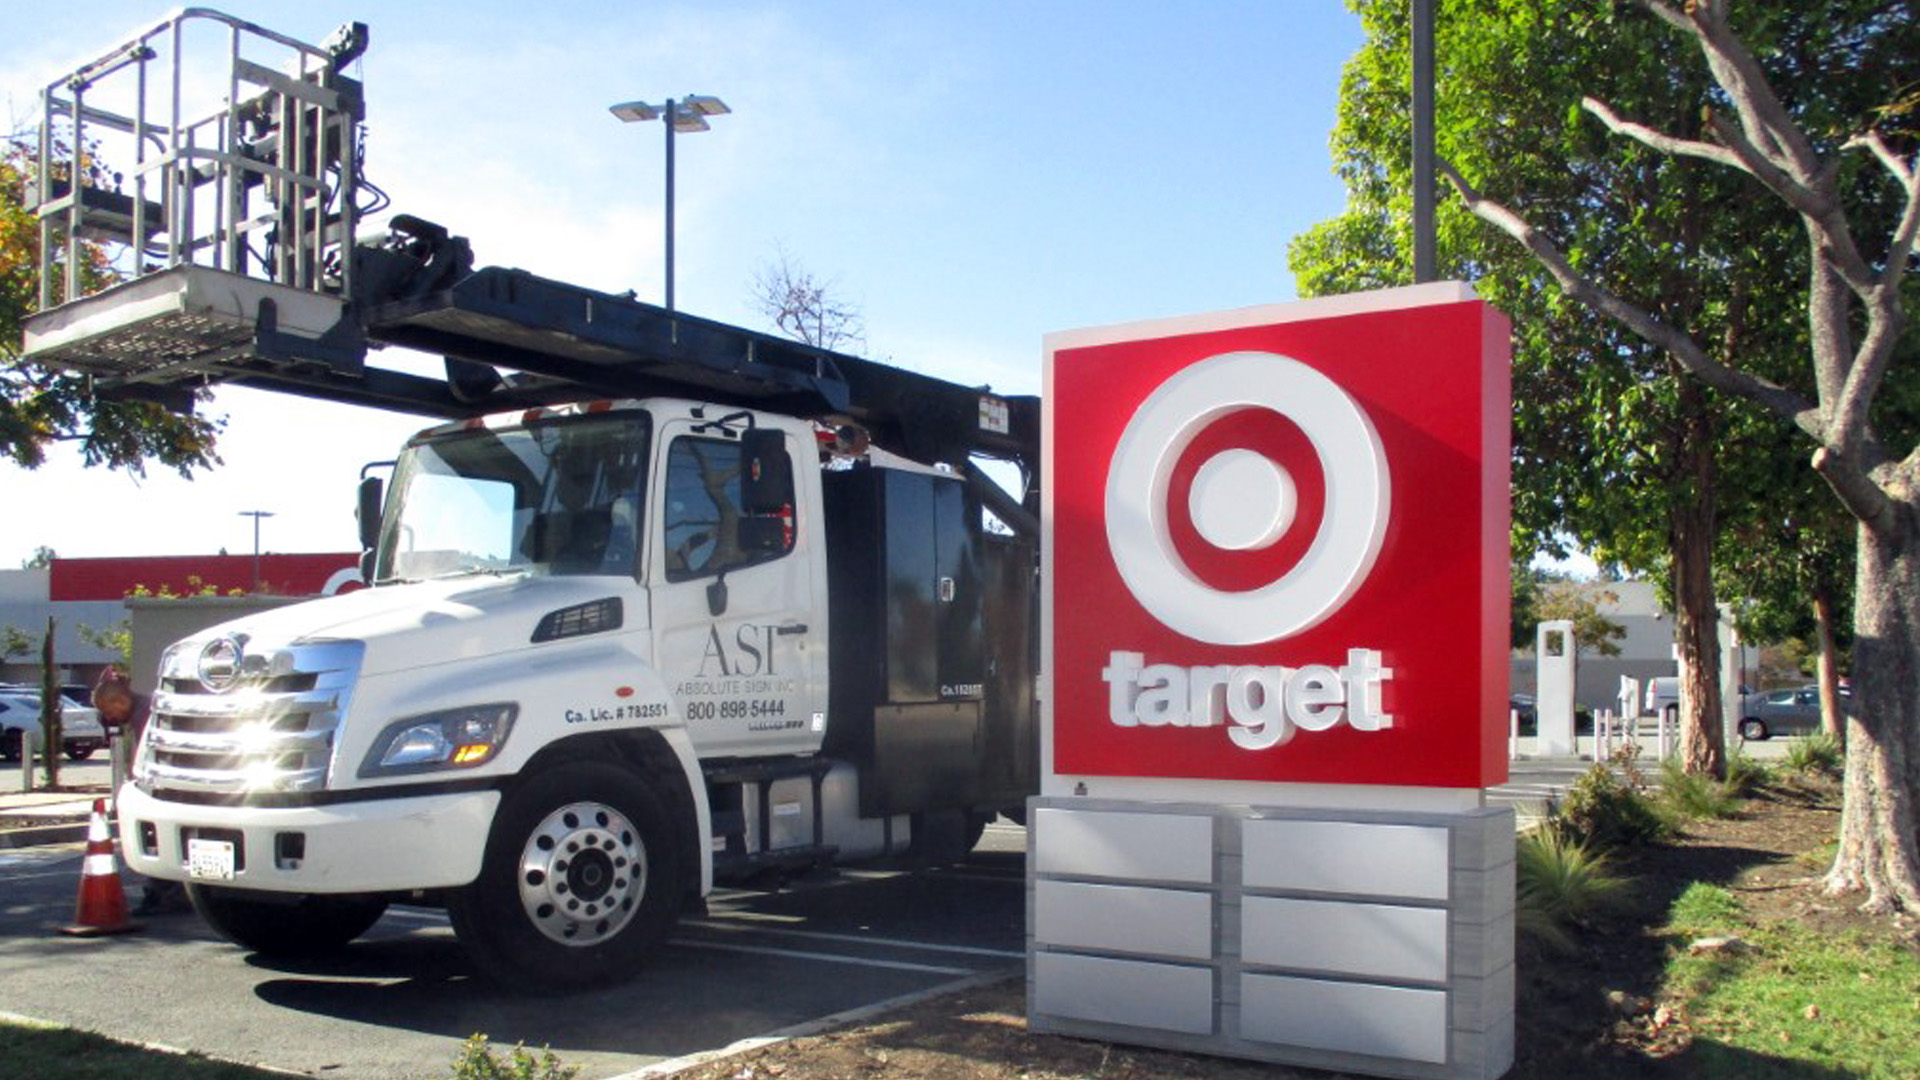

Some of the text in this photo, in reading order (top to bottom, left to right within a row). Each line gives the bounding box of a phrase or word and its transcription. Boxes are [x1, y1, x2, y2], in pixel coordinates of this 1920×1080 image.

[675, 681, 740, 696] ABSOLUTE
[744, 680, 771, 693] SIGN
[1102, 647, 1393, 750] target
[565, 709, 587, 723] Ca.
[590, 707, 613, 722] Lic.
[616, 707, 624, 719] #
